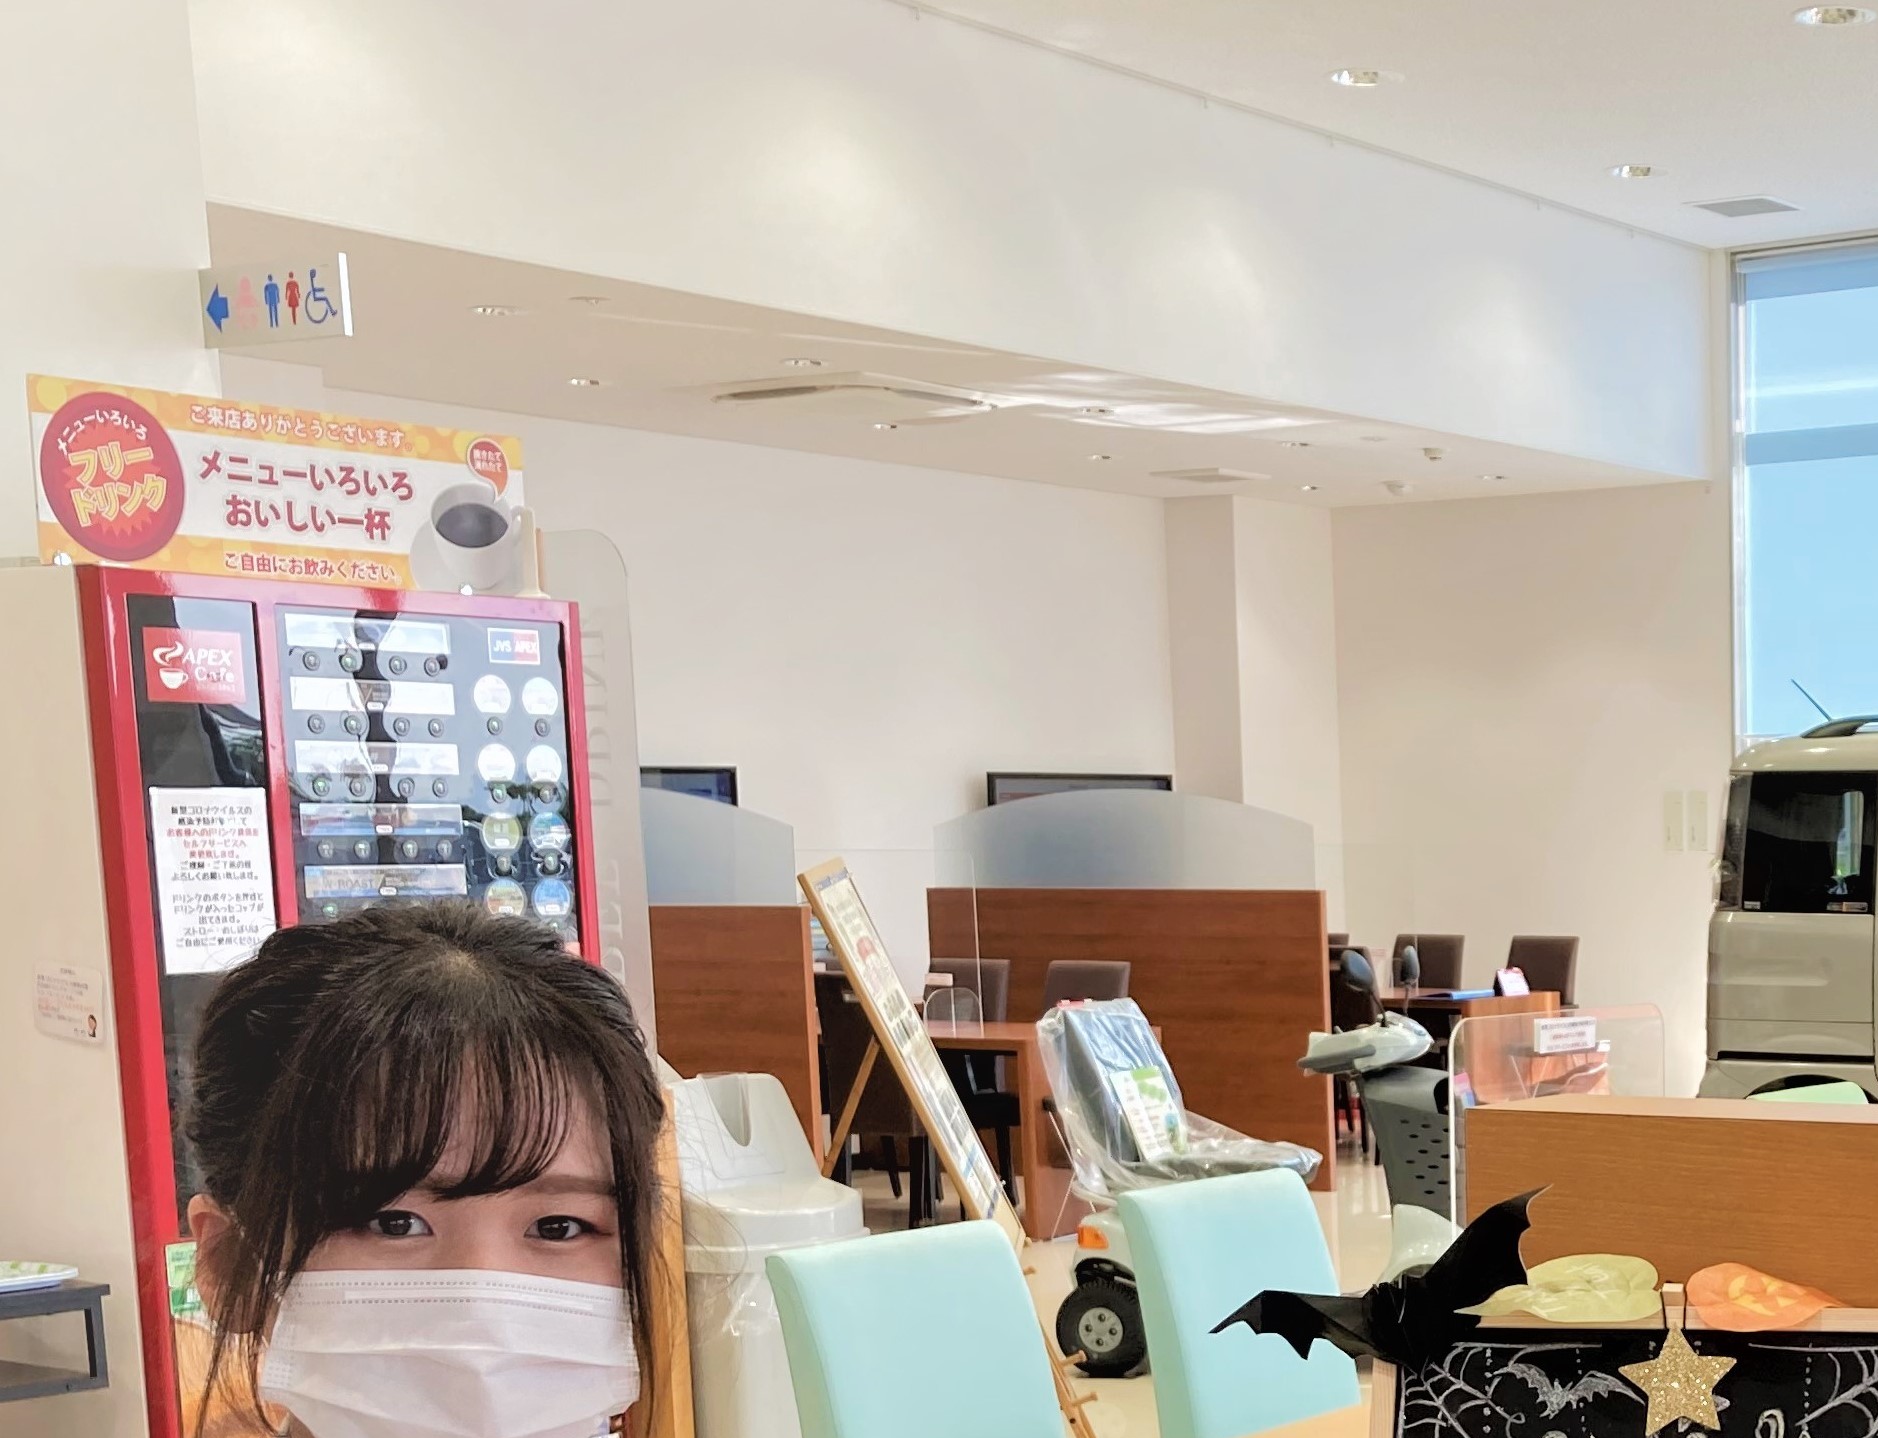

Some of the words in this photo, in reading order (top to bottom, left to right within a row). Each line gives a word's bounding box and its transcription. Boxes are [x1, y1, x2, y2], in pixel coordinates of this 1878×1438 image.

[57, 409, 148, 454] メニューいろいろ
[190, 404, 412, 451] ご来店ありがとうございます。
[68, 441, 154, 486] フリー
[200, 450, 414, 501] メニューいろいろ
[70, 473, 167, 528] ドリンク
[225, 494, 392, 541] おいしい一杯
[182, 648, 233, 667] APEX
